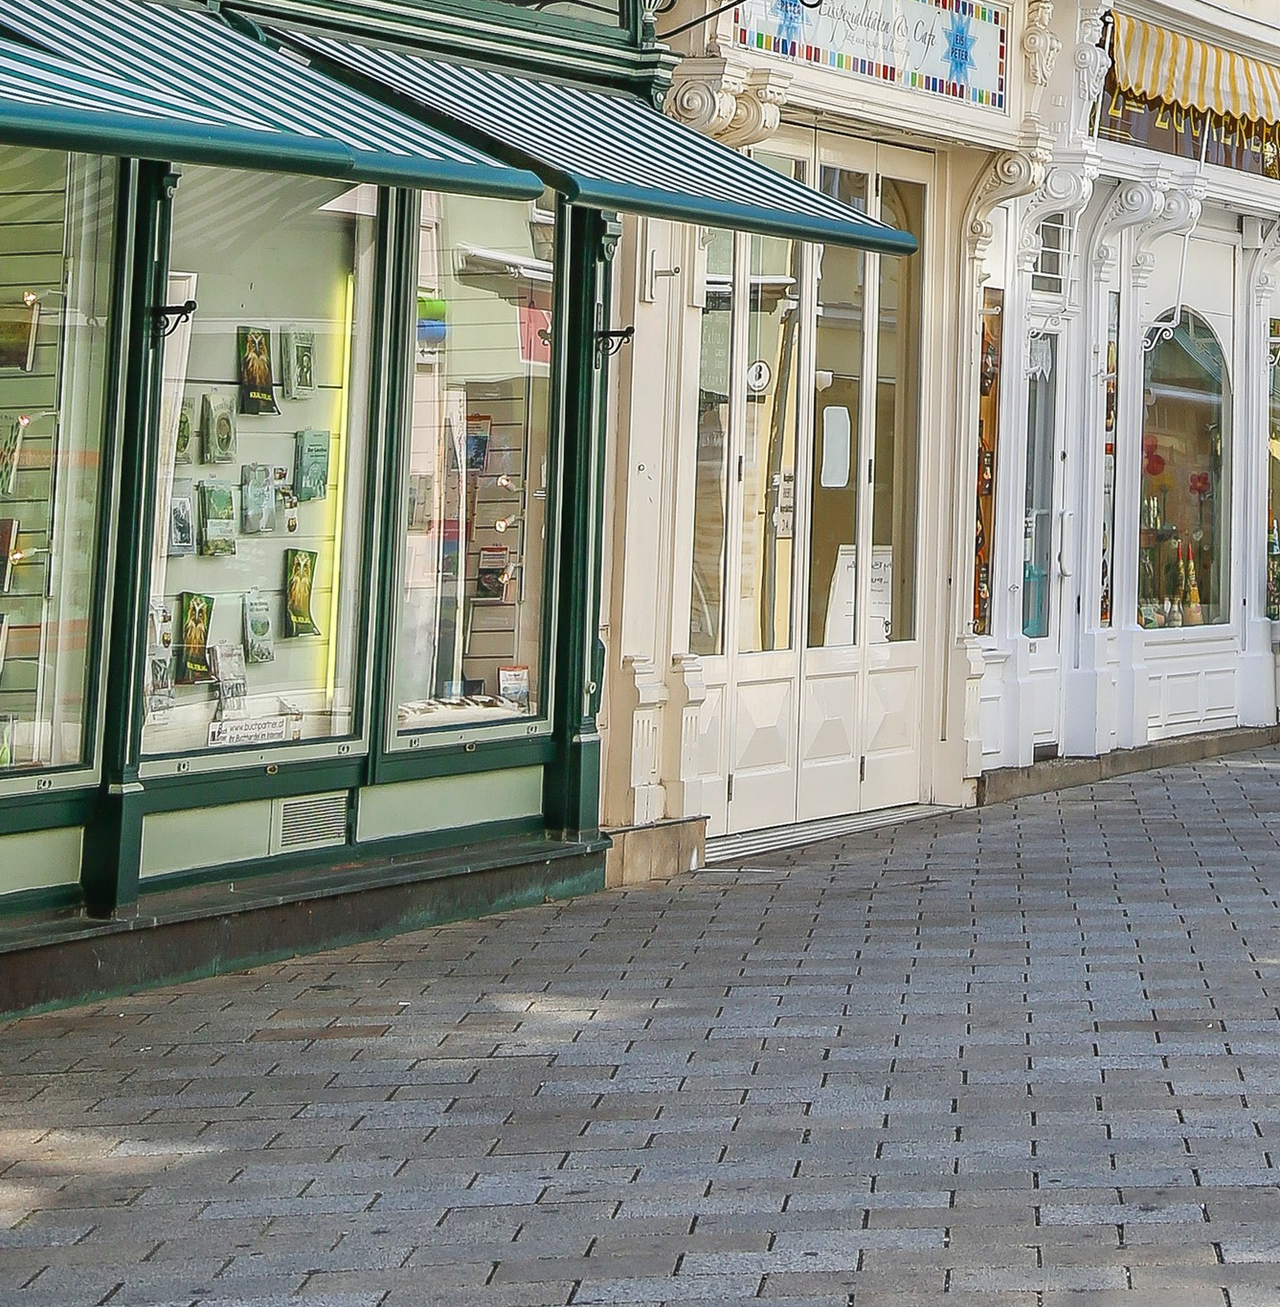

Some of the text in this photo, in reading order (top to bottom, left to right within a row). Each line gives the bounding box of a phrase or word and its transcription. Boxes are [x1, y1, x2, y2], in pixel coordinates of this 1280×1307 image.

[780, 0, 802, 15] PETER
[955, 34, 965, 46] EIS
[950, 48, 969, 63] PETER
